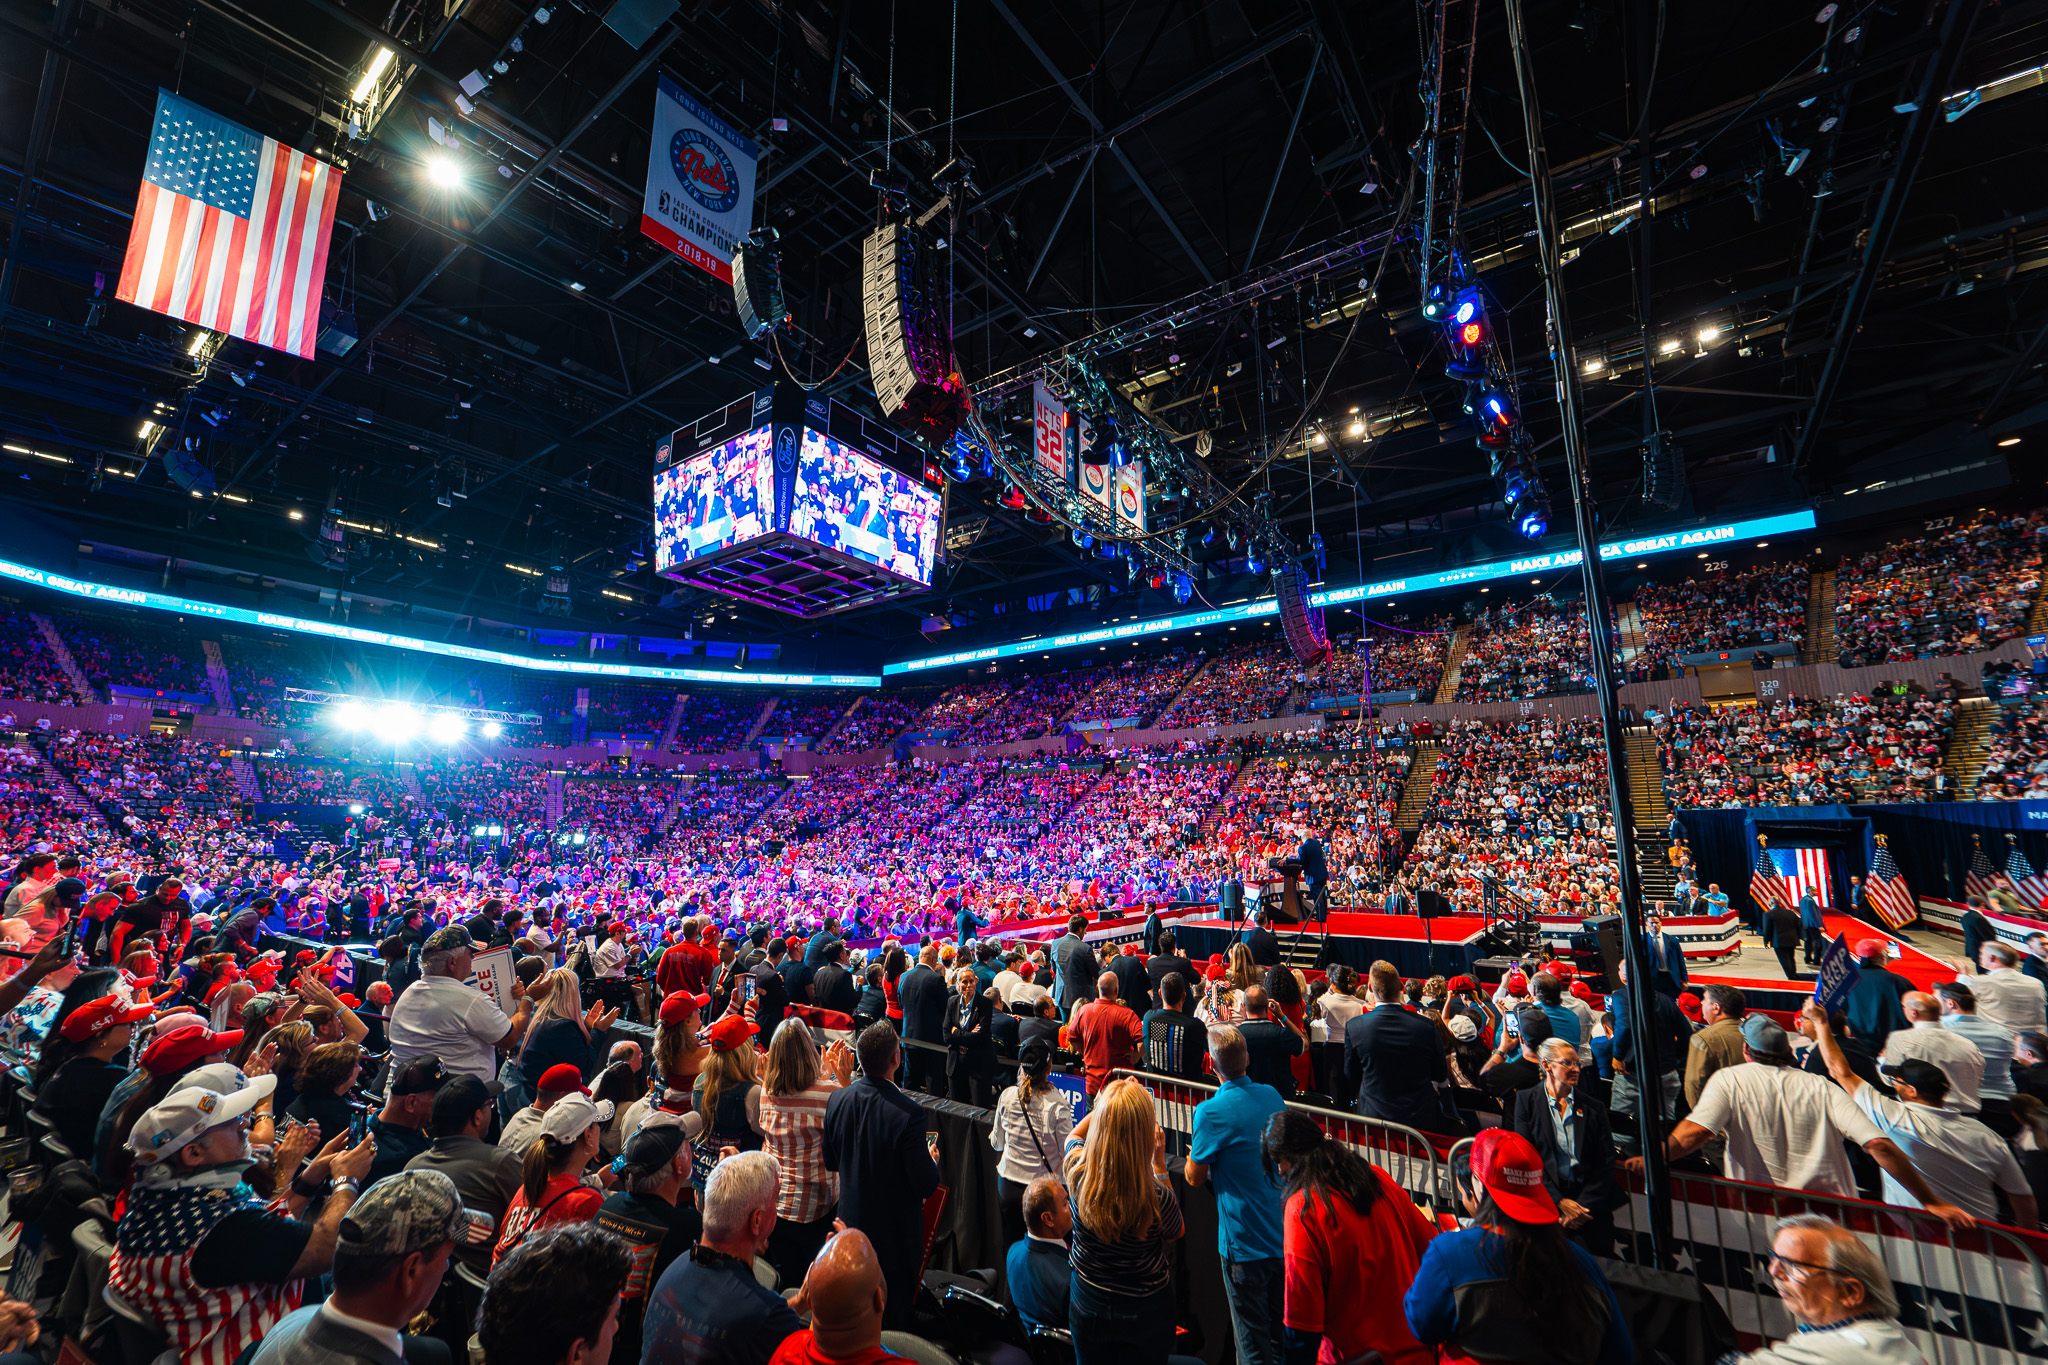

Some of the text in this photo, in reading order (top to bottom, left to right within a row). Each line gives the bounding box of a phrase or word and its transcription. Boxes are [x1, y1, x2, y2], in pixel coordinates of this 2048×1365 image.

[675, 91, 744, 148] LONG ISLAND NETS
[680, 131, 733, 172] LONG ISLAND
[680, 148, 731, 192] Nets
[682, 179, 725, 210] NEW YORK
[674, 197, 739, 242] EASTERN CONFERENCE
[677, 240, 717, 271] 2018-19
[1037, 400, 1061, 433] NETS
[780, 435, 793, 465] Ford
[1037, 419, 1062, 465] 32
[926, 466, 940, 479] TCL
[1924, 516, 1954, 531] 227
[1510, 527, 1735, 572] MAKE AMECA GREAT AGAIN
[1705, 561, 1728, 572] 226
[47, 576, 94, 595] GREAT
[96, 586, 146, 603] AGAIN
[1247, 601, 1277, 616] MAKE
[1328, 588, 1365, 602] GREAT
[1368, 581, 1406, 595] AGAIN
[1054, 620, 1172, 646] MAKE AMERICA GREAT AGAIN
[977, 648, 999, 659] AGAIN
[1761, 680, 1779, 688] 120
[336, 953, 353, 984] 47
[1822, 947, 1848, 980] UMP
[91, 1014, 114, 1031] 45-47
[699, 1152, 719, 1169] 202
[1503, 1167, 1523, 1177] MAKE
[1507, 1175, 1528, 1185] GREAT
[598, 1216, 649, 1239] NEVER FORGET
